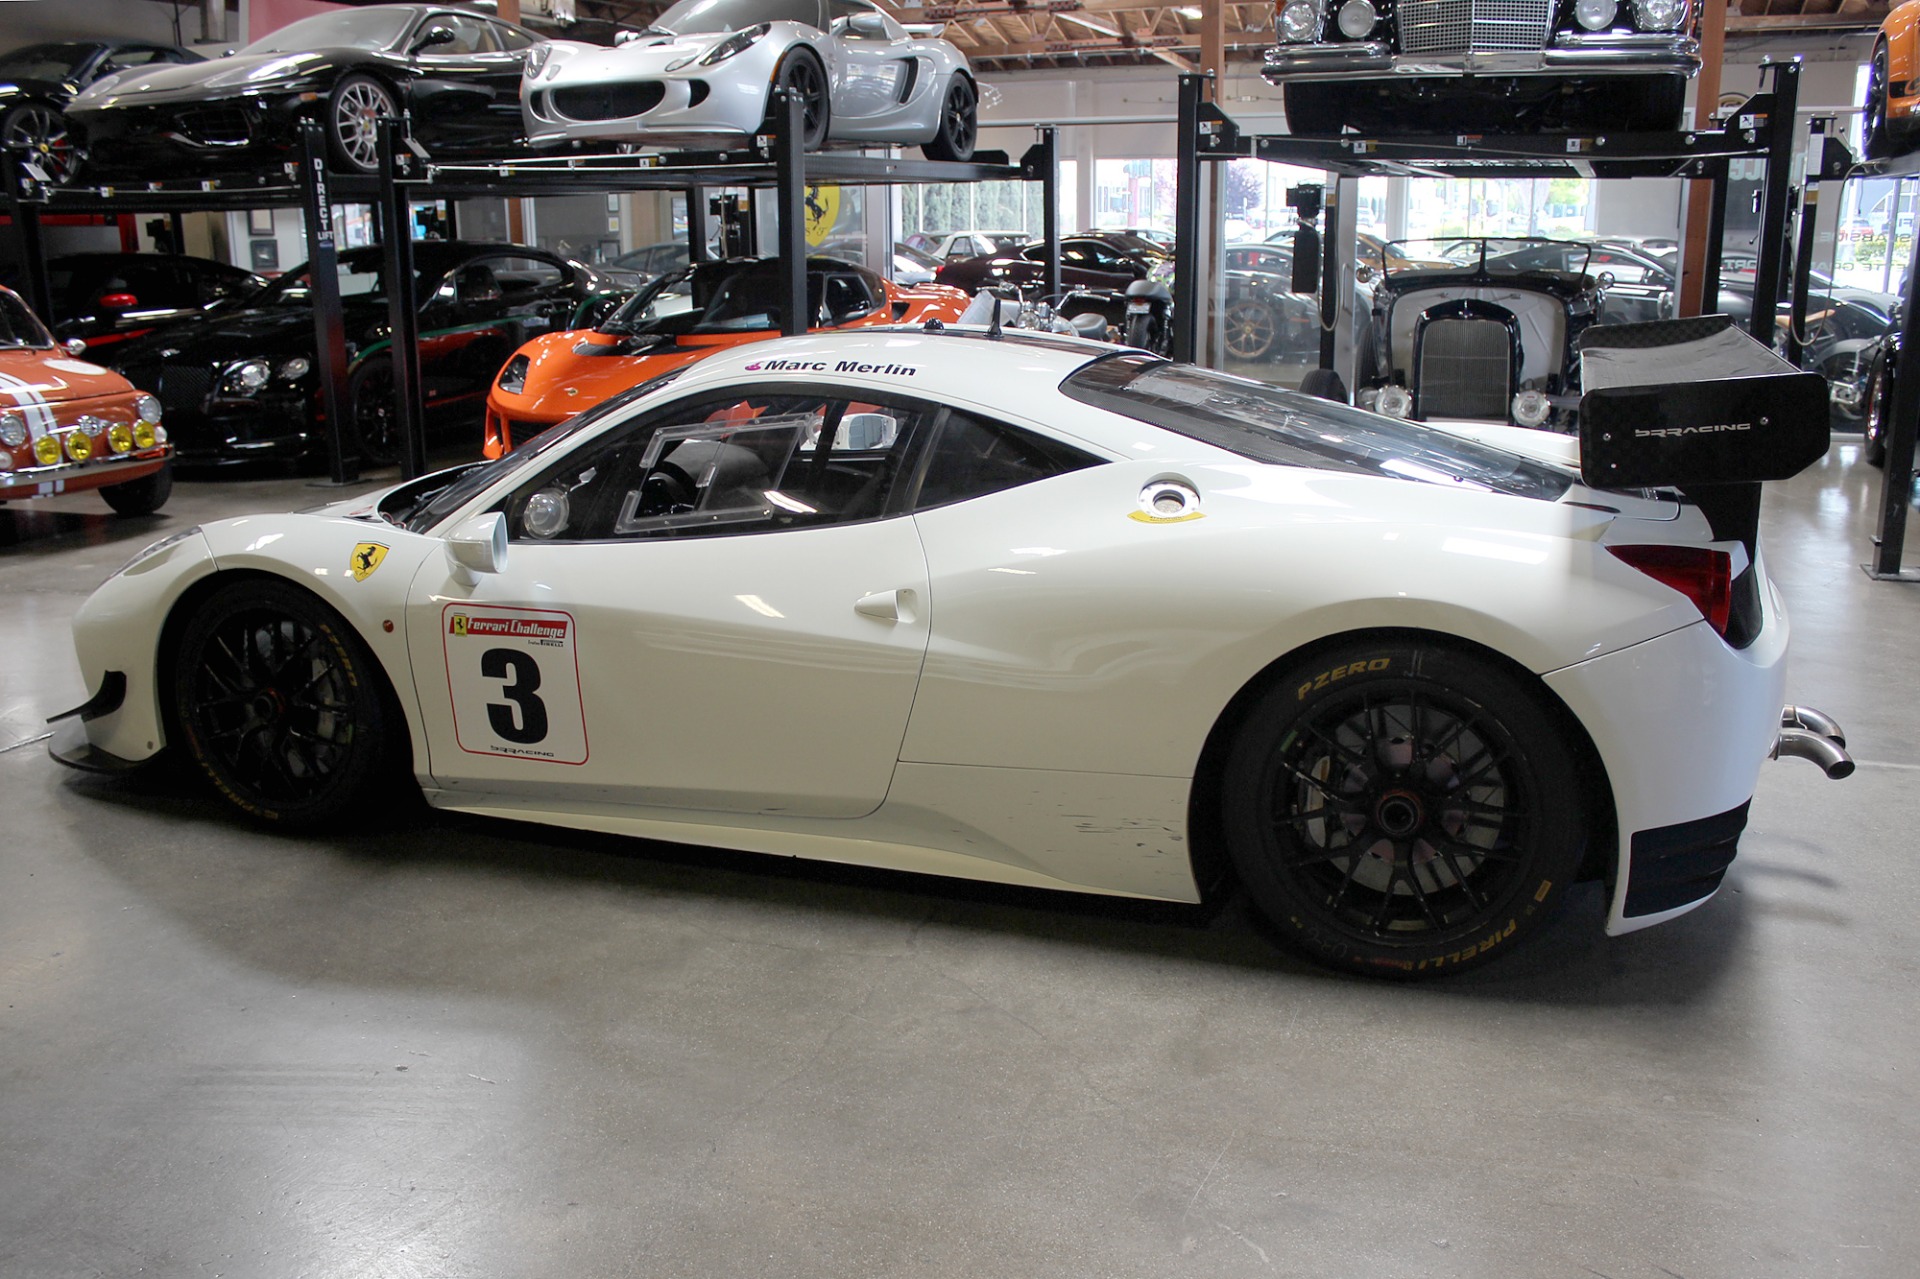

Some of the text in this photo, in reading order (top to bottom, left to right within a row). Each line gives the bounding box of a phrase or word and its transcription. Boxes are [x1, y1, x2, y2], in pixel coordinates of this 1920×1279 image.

[313, 157, 328, 231] DIRECT
[317, 231, 334, 240] LIFT
[764, 360, 917, 376] Marc Merlin
[467, 617, 565, 639] Ferrari Challenge
[480, 647, 549, 745] 3
[1417, 918, 1517, 971] PIRELLI
